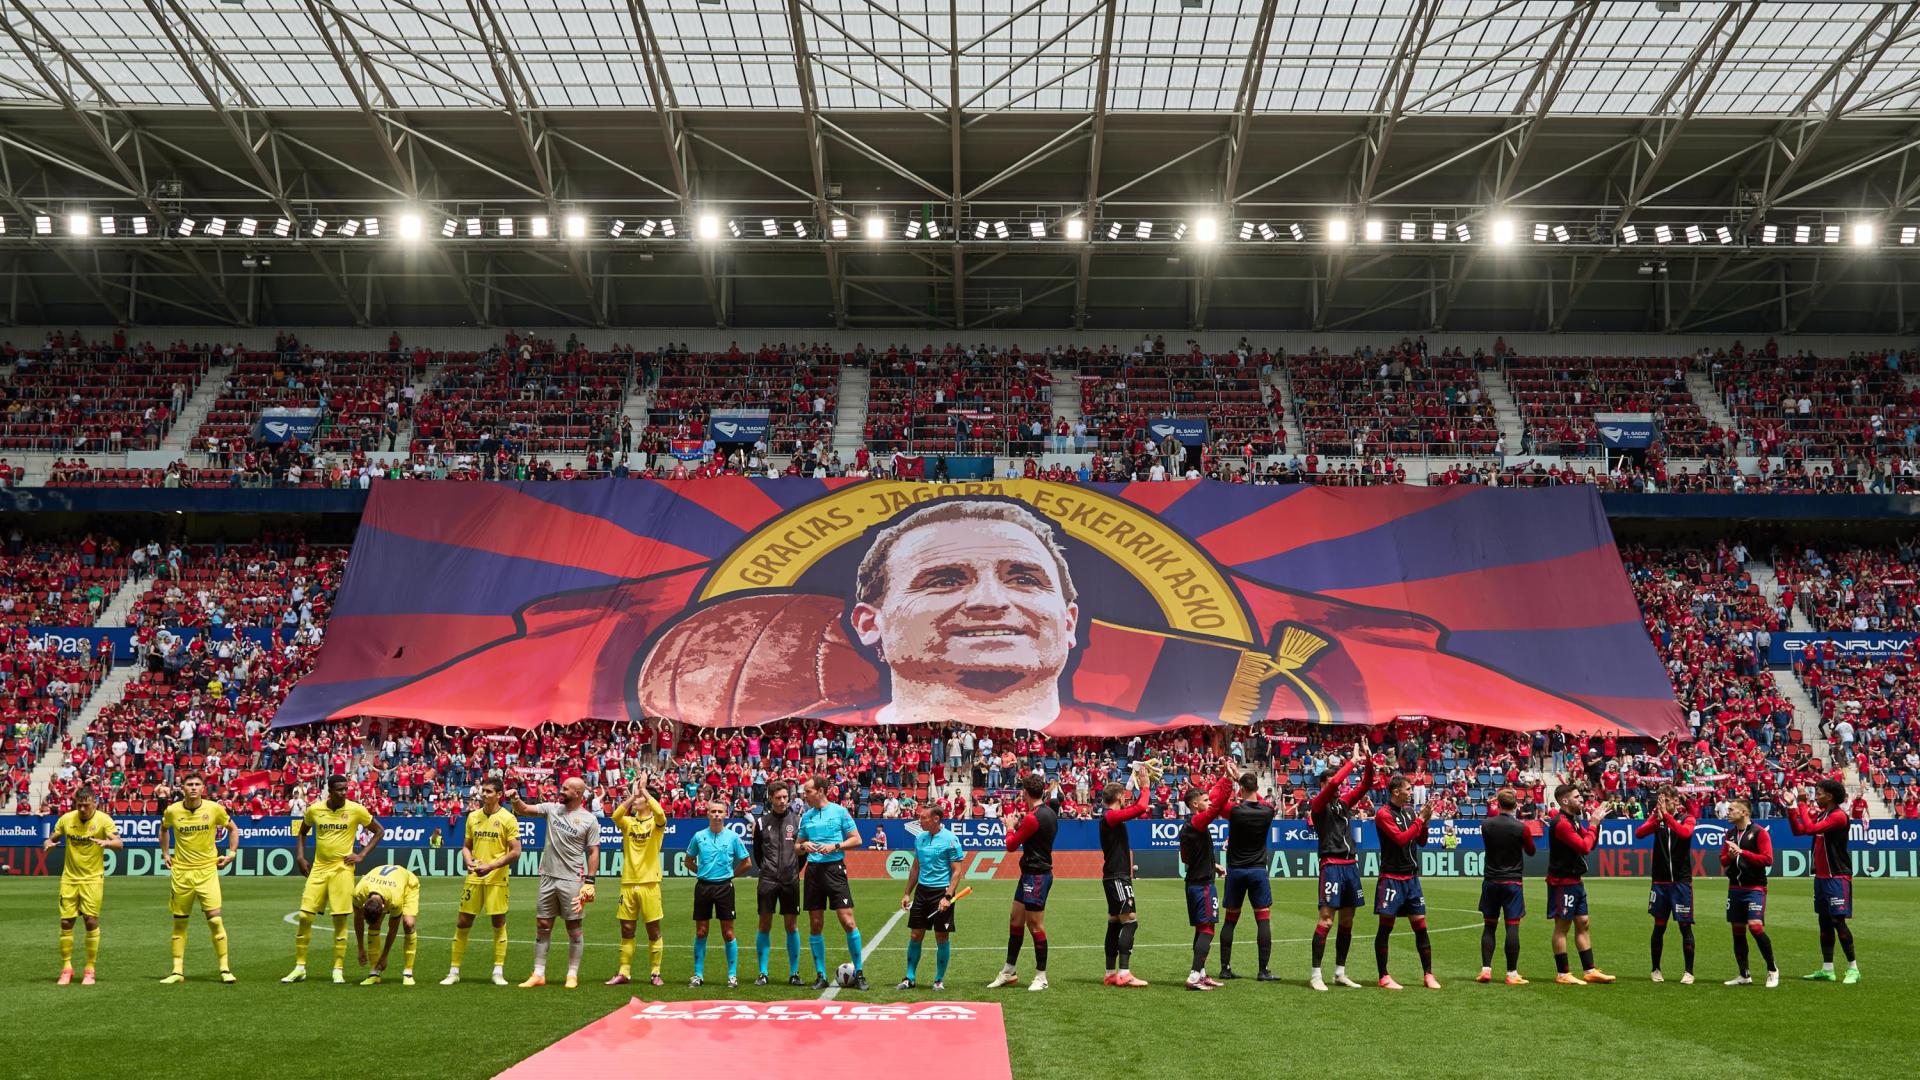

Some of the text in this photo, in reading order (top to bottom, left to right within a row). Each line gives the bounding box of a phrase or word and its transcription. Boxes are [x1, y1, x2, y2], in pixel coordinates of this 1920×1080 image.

[739, 507, 854, 586] GRACIAS
[1031, 489, 1182, 574] ESKERRIK
[1162, 567, 1226, 630] ASKO
[0, 826, 37, 836] ixaBank
[114, 819, 162, 836] sner
[179, 824, 209, 833] PAMESA
[238, 826, 292, 838] agamóvil
[383, 825, 425, 841] otor
[518, 822, 536, 837] ER
[950, 822, 974, 836] EL
[1848, 823, 1899, 845] Miguel
[474, 830, 499, 839] PAMESA
[1598, 824, 1633, 845] hol
[963, 838, 982, 847] C.A.
[127, 848, 175, 876] DE
[891, 856, 911, 867] EA
[1421, 851, 1459, 876] DEL
[1325, 882, 1339, 895] 24
[1385, 888, 1397, 902] 17
[1212, 896, 1219, 909] 3
[1563, 894, 1575, 907] 12
[641, 1005, 977, 1015] LALIGA
